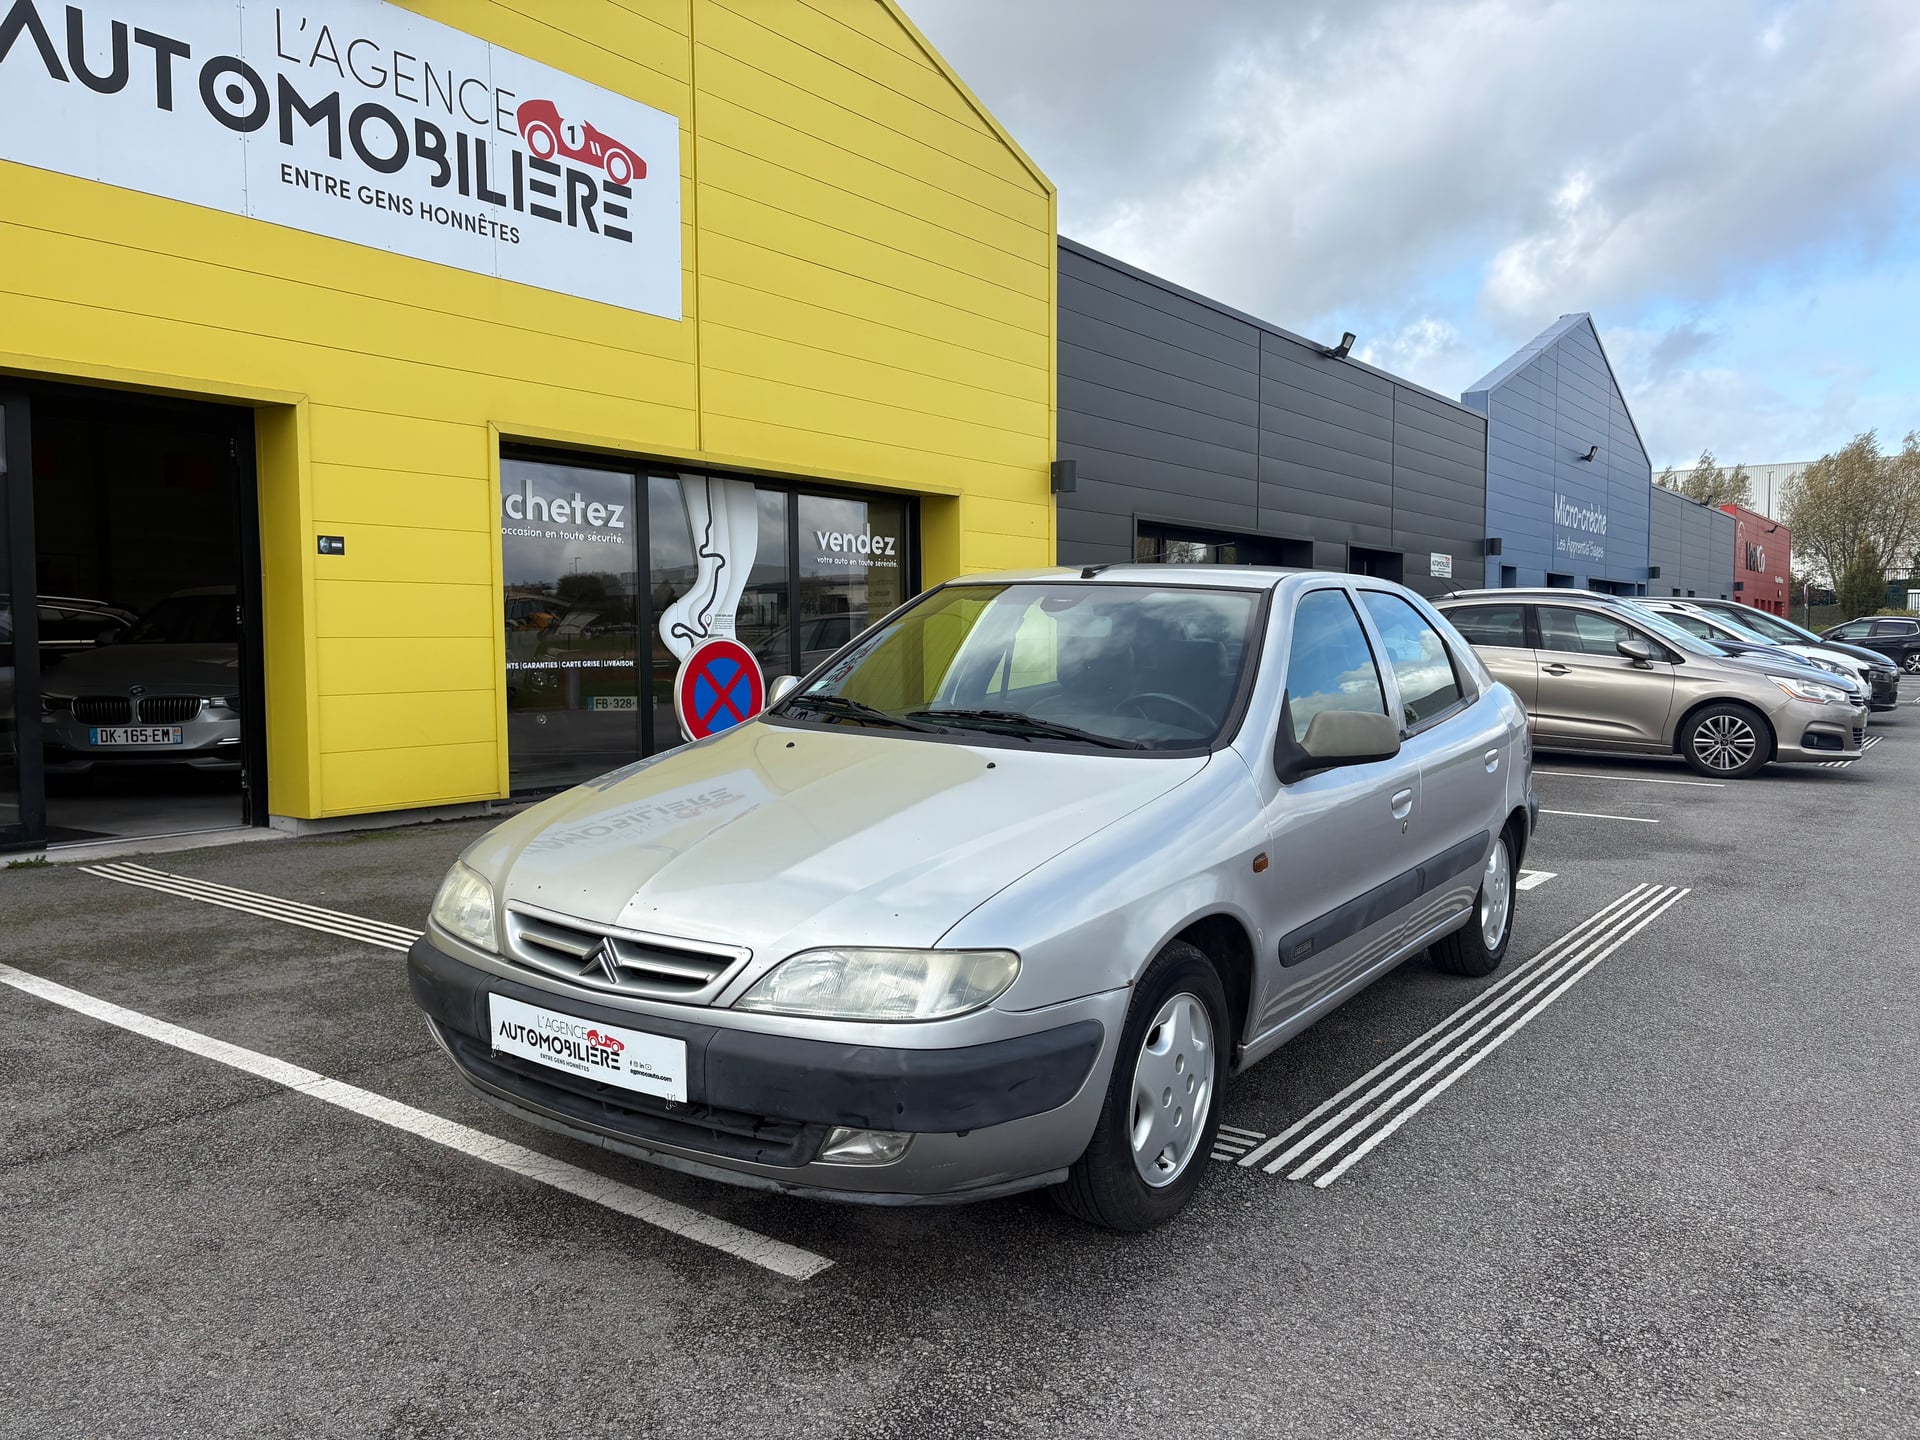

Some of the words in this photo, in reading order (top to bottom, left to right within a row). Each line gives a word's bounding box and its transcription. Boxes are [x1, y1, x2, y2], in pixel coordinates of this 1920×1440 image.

[275, 8, 518, 136] L'AGENCE
[0, 0, 634, 243] AUTOMOBILIERE
[281, 163, 351, 200] ENTRE
[357, 185, 414, 216] GENS
[420, 201, 520, 244] HONNÊTES
[500, 479, 625, 528] chetez
[1554, 492, 1607, 536] Micro-crèche
[545, 529, 557, 539] en
[559, 530, 584, 541] toute
[587, 531, 625, 544] sécurité.
[816, 523, 896, 556] vendez
[816, 556, 833, 564] votre
[858, 559, 874, 567] toute
[522, 660, 558, 669] GARANTIES
[561, 660, 582, 668] CARTE
[582, 659, 601, 667] GRISE
[603, 659, 634, 667] LIVRAISON
[100, 728, 170, 744] DK-165-EM
[536, 1014, 588, 1041] L'AGENCE
[499, 1020, 621, 1071] AUTOMOBILIERE
[540, 1052, 553, 1062] ENTRE
